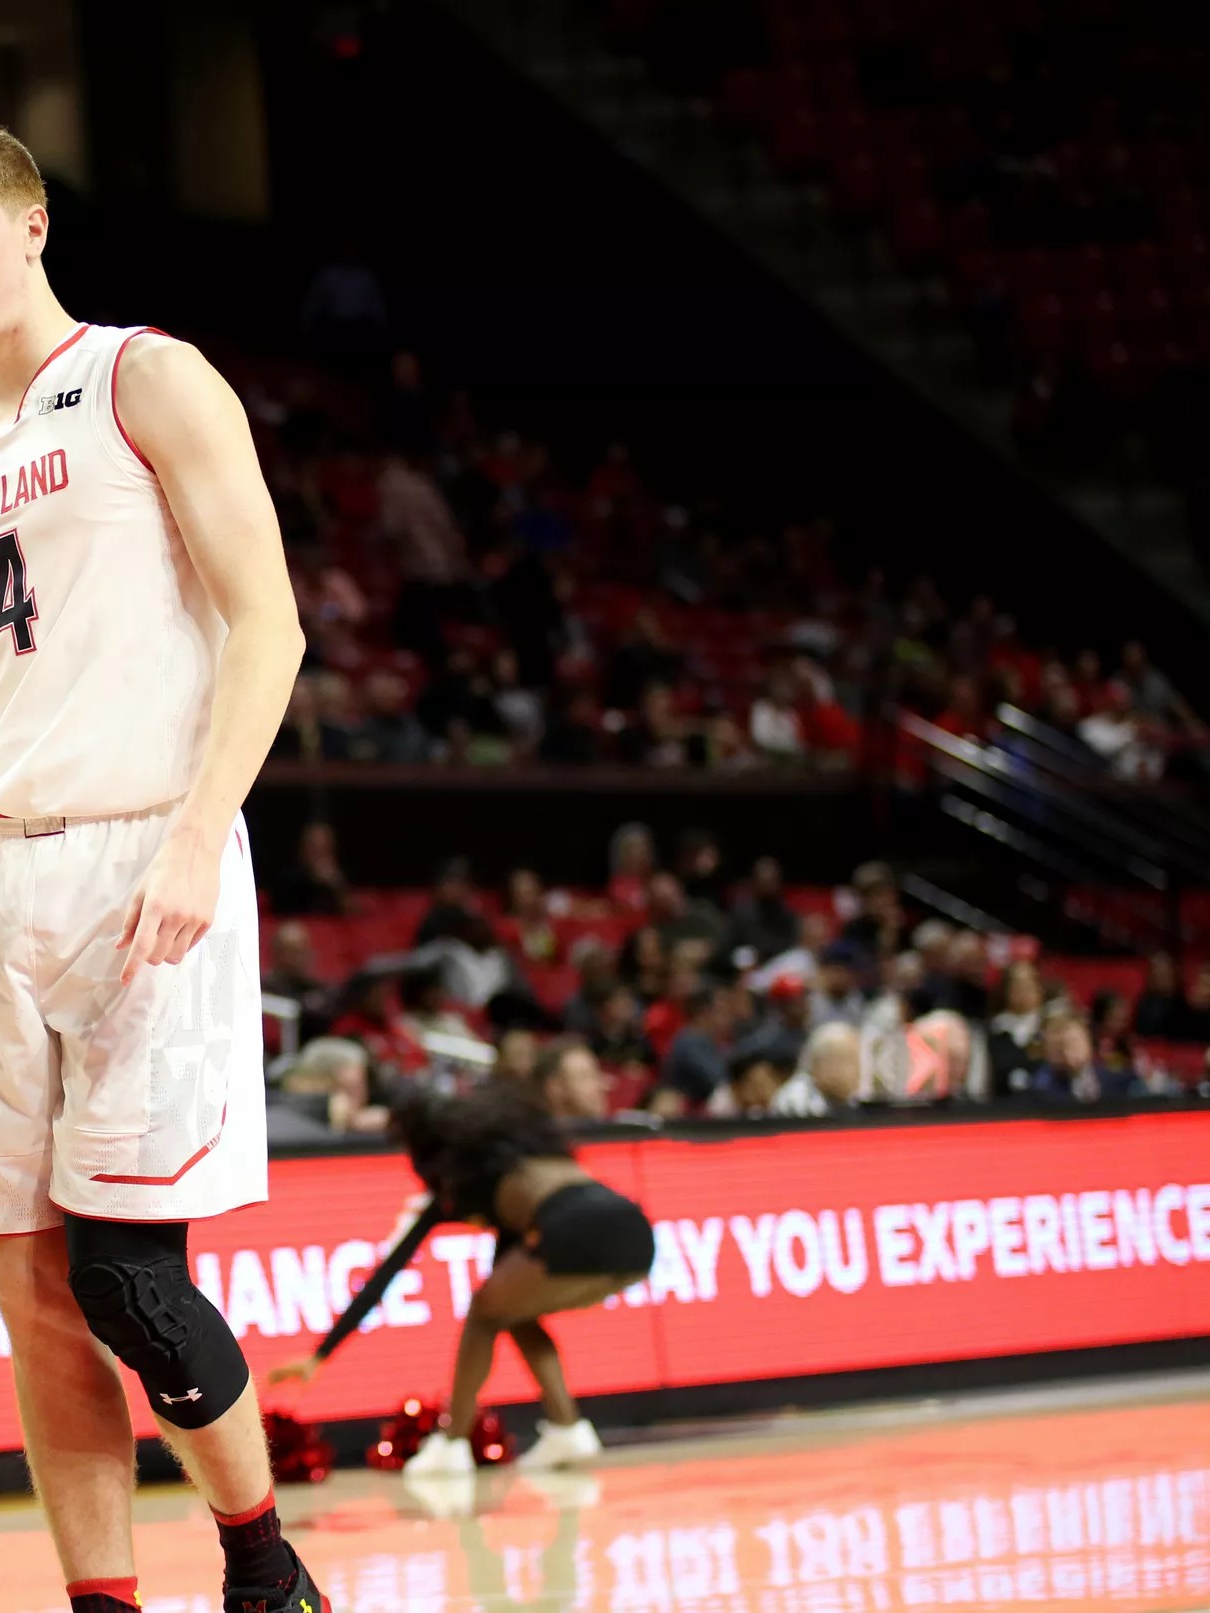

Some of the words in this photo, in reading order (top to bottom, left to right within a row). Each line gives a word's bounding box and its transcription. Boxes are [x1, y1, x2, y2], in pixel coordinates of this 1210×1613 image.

[603, 1218, 725, 1311] AY
[730, 1208, 868, 1297] YOU
[875, 1183, 1210, 1286] EXPERIENCE
